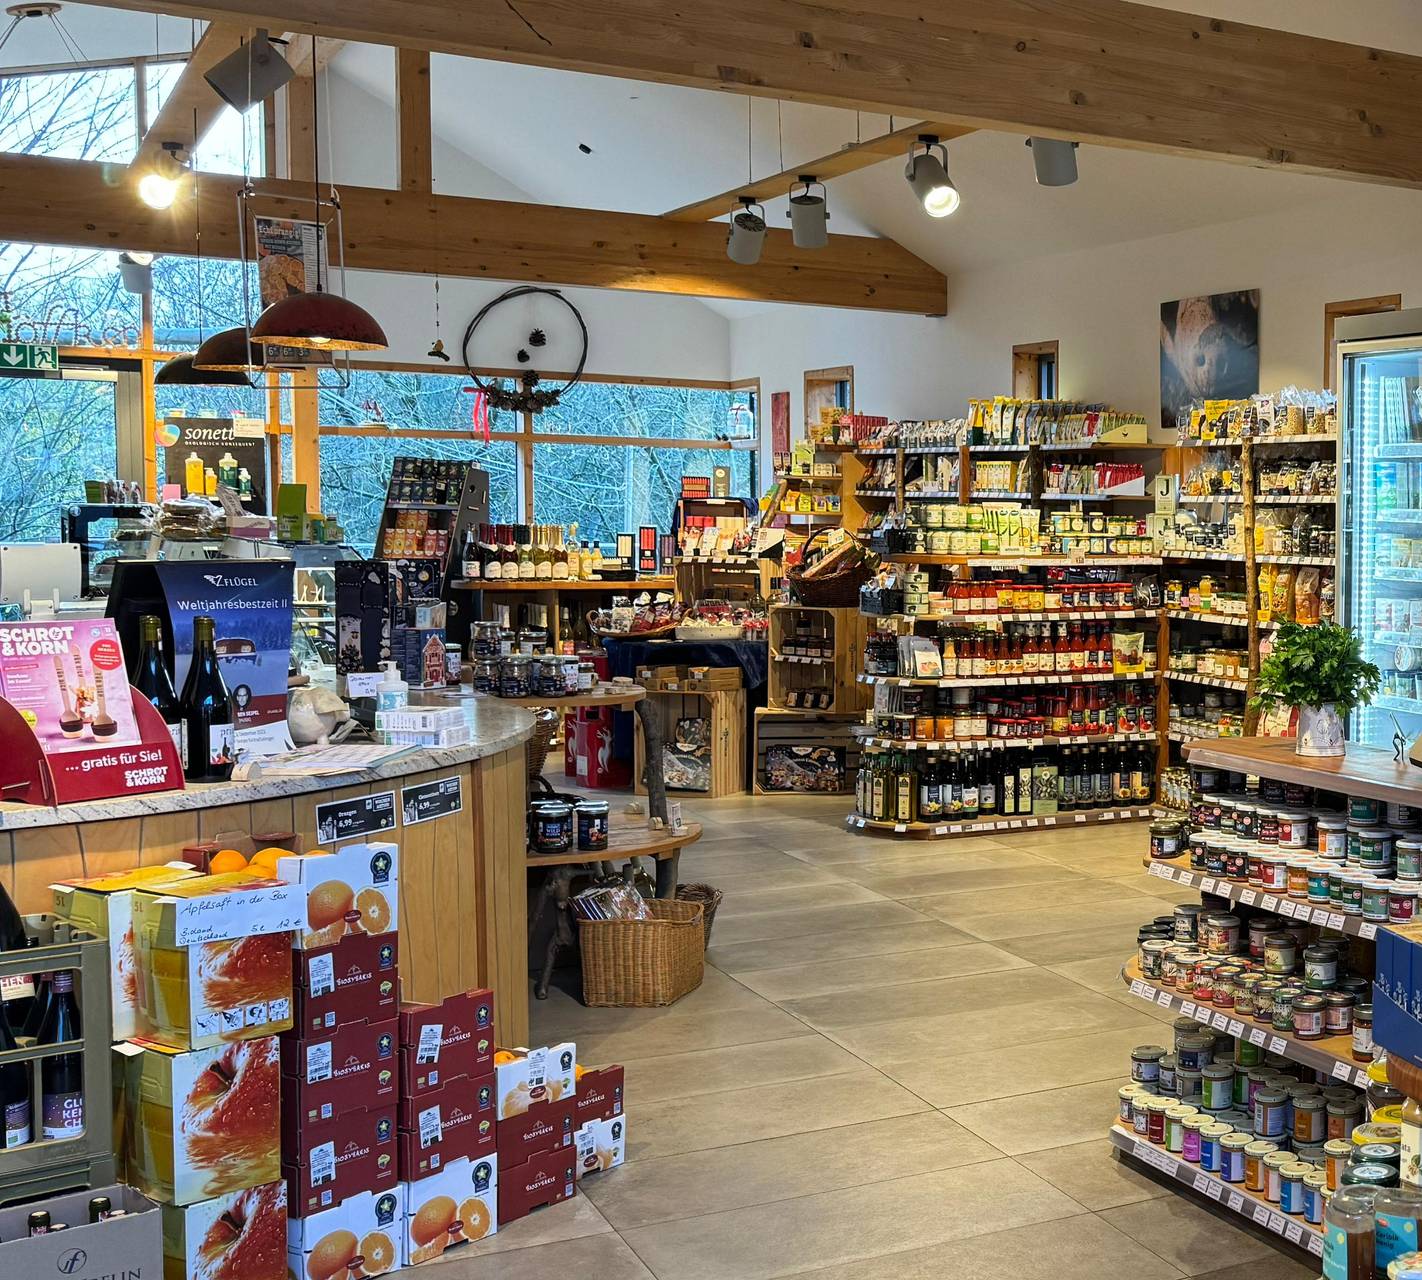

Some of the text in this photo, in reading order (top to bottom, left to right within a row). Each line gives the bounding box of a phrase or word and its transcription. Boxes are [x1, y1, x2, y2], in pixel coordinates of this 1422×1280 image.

[184, 427, 235, 441] sonett
[177, 598, 279, 612] Weltjahresbestzeit
[0, 626, 74, 642] SCHROT
[82, 755, 118, 772] gratis
[119, 752, 138, 764] für
[138, 750, 162, 763] Sie!
[124, 766, 168, 779] SCHROT
[180, 890, 288, 916] Apfelsaft in der Box
[277, 919, 290, 928] 12
